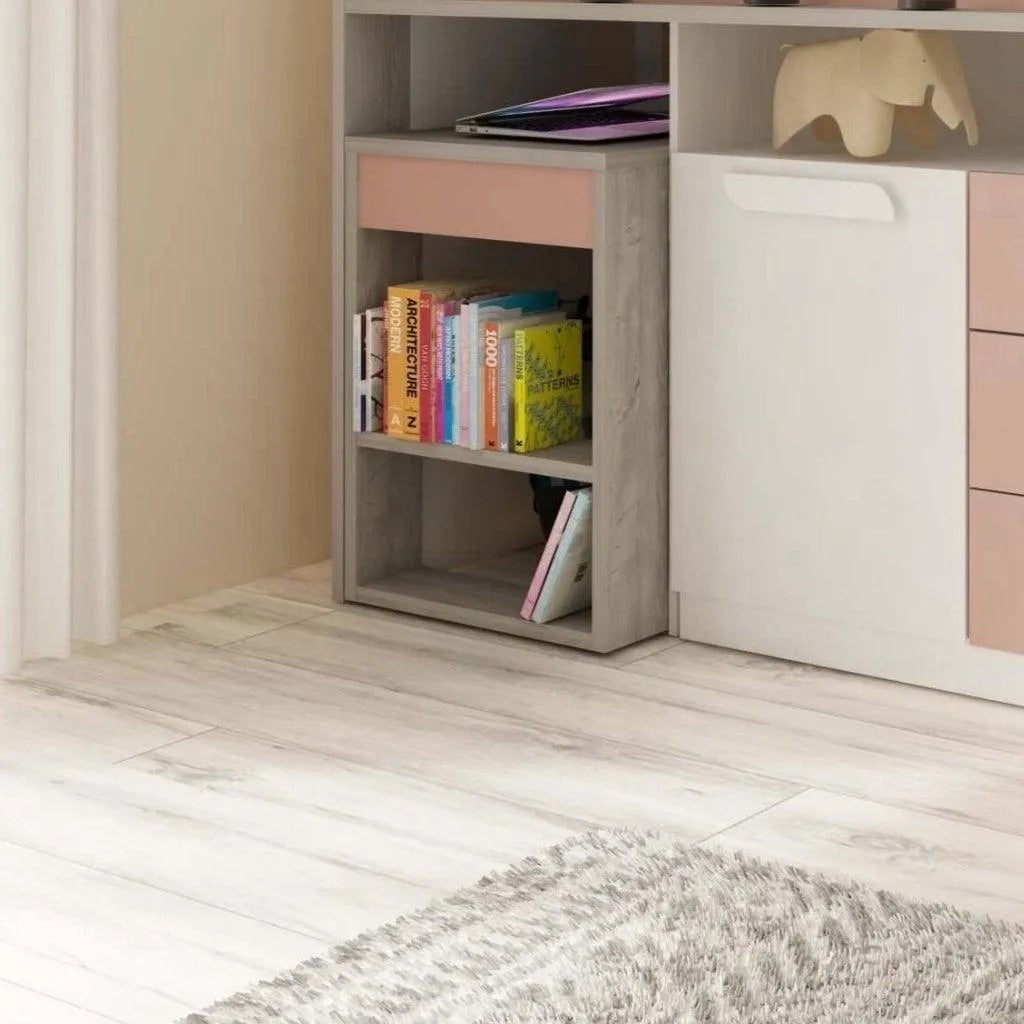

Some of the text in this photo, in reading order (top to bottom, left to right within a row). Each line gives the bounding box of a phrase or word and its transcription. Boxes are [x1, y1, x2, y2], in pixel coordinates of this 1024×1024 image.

[389, 296, 402, 354] MODERN
[406, 297, 418, 398] ARCHITECTURE
[485, 329, 498, 368] 1000
[515, 331, 524, 380] PATTERNS
[528, 374, 580, 394] PATTERNS
[391, 413, 401, 425] A
